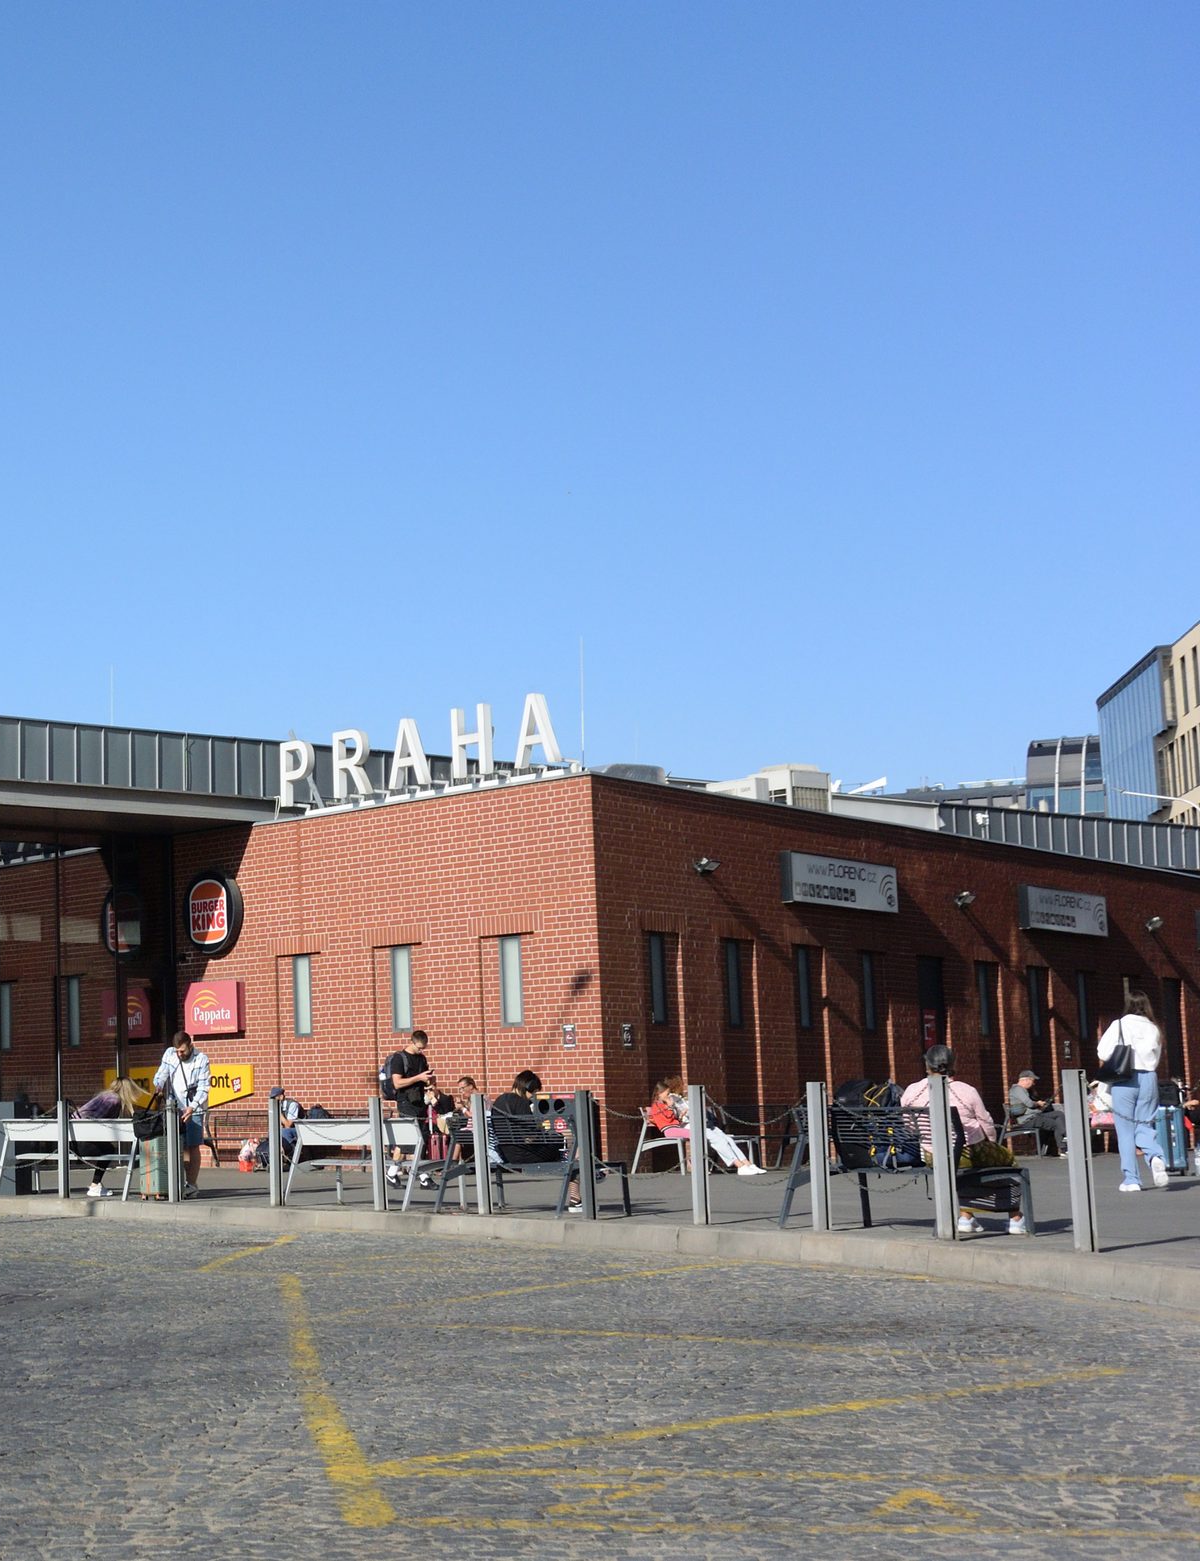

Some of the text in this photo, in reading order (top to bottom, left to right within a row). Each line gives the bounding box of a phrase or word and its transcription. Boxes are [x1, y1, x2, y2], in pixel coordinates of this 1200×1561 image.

[280, 692, 563, 808] PRAHA
[191, 899, 225, 914] BURGER
[191, 911, 226, 931] KING
[194, 1007, 231, 1025] Pappata
